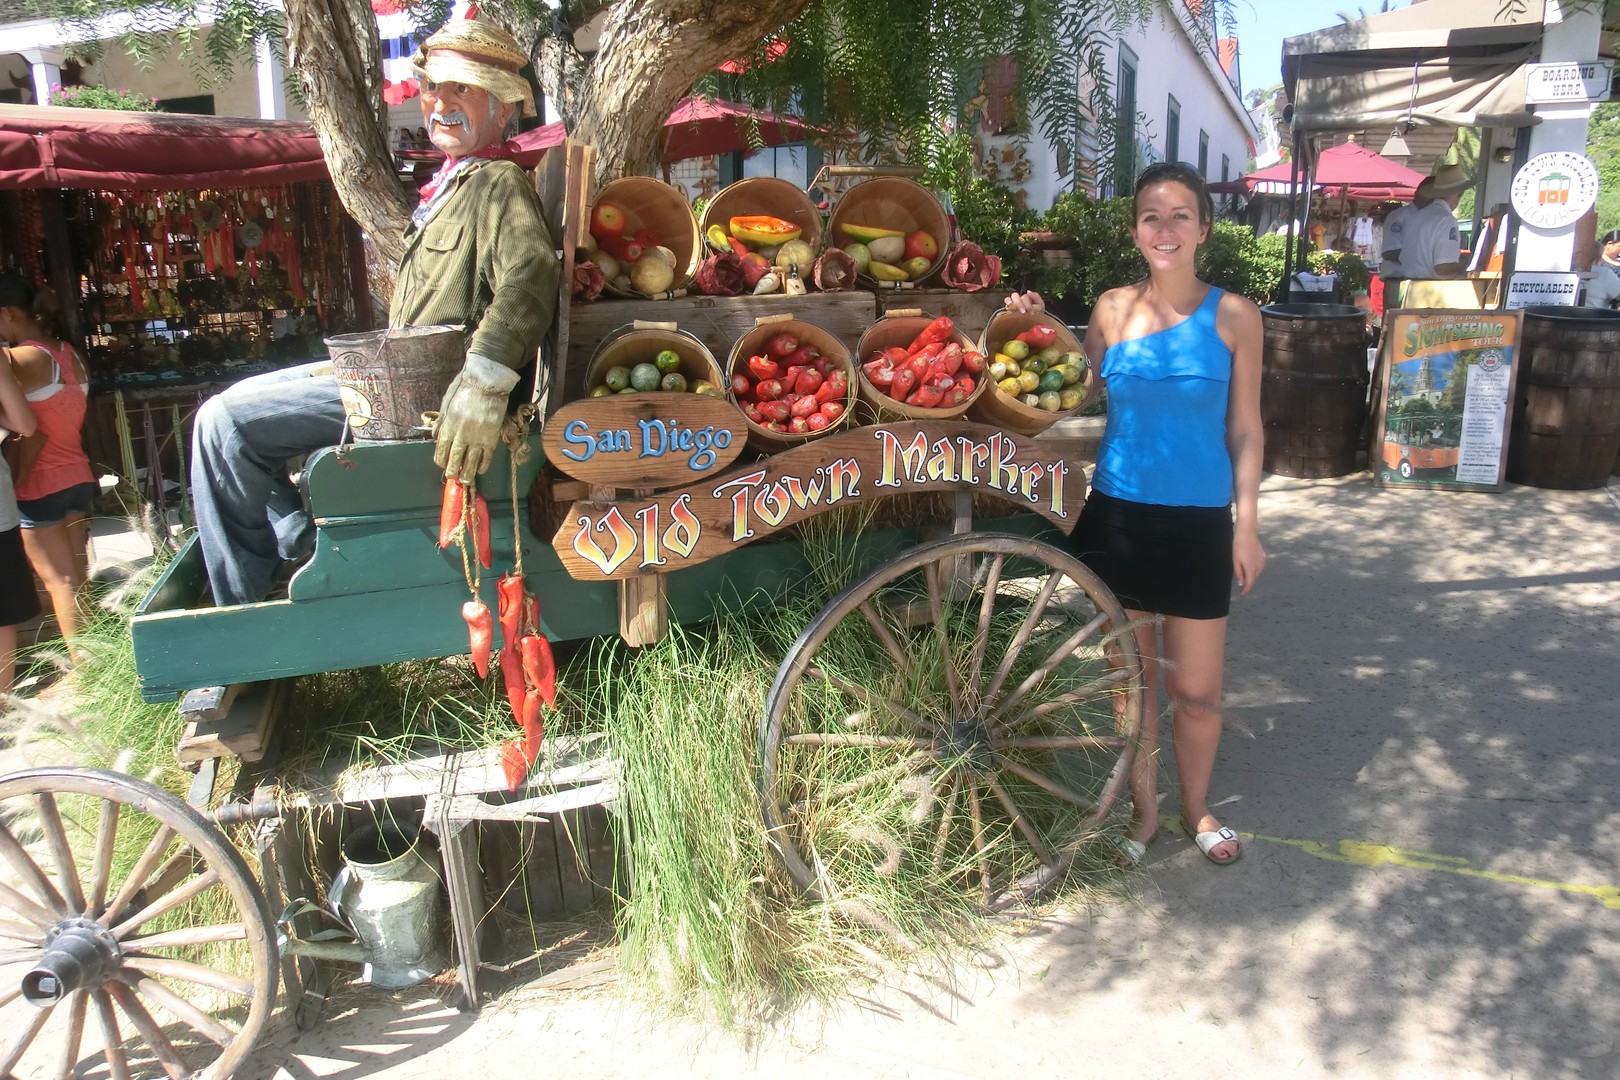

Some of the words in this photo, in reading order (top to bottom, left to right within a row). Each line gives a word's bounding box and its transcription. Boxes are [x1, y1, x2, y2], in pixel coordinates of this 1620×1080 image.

[1542, 67, 1595, 82] BOARDING
[1552, 83, 1581, 96] HERE
[1514, 177, 1529, 197] OLD
[1523, 153, 1557, 176] TOWN
[1562, 153, 1595, 196] TROLLEY
[1524, 205, 1580, 226] TOURS
[1511, 282, 1574, 294] RECYCLABLES
[1419, 318, 1434, 326] San
[1403, 322, 1505, 357] SIGHTSEEING
[1472, 337, 1503, 347] TOUR
[560, 419, 633, 462] San
[637, 418, 733, 471] Diego
[573, 493, 702, 575] Old
[712, 456, 862, 542] Town
[874, 429, 1069, 519] Market
